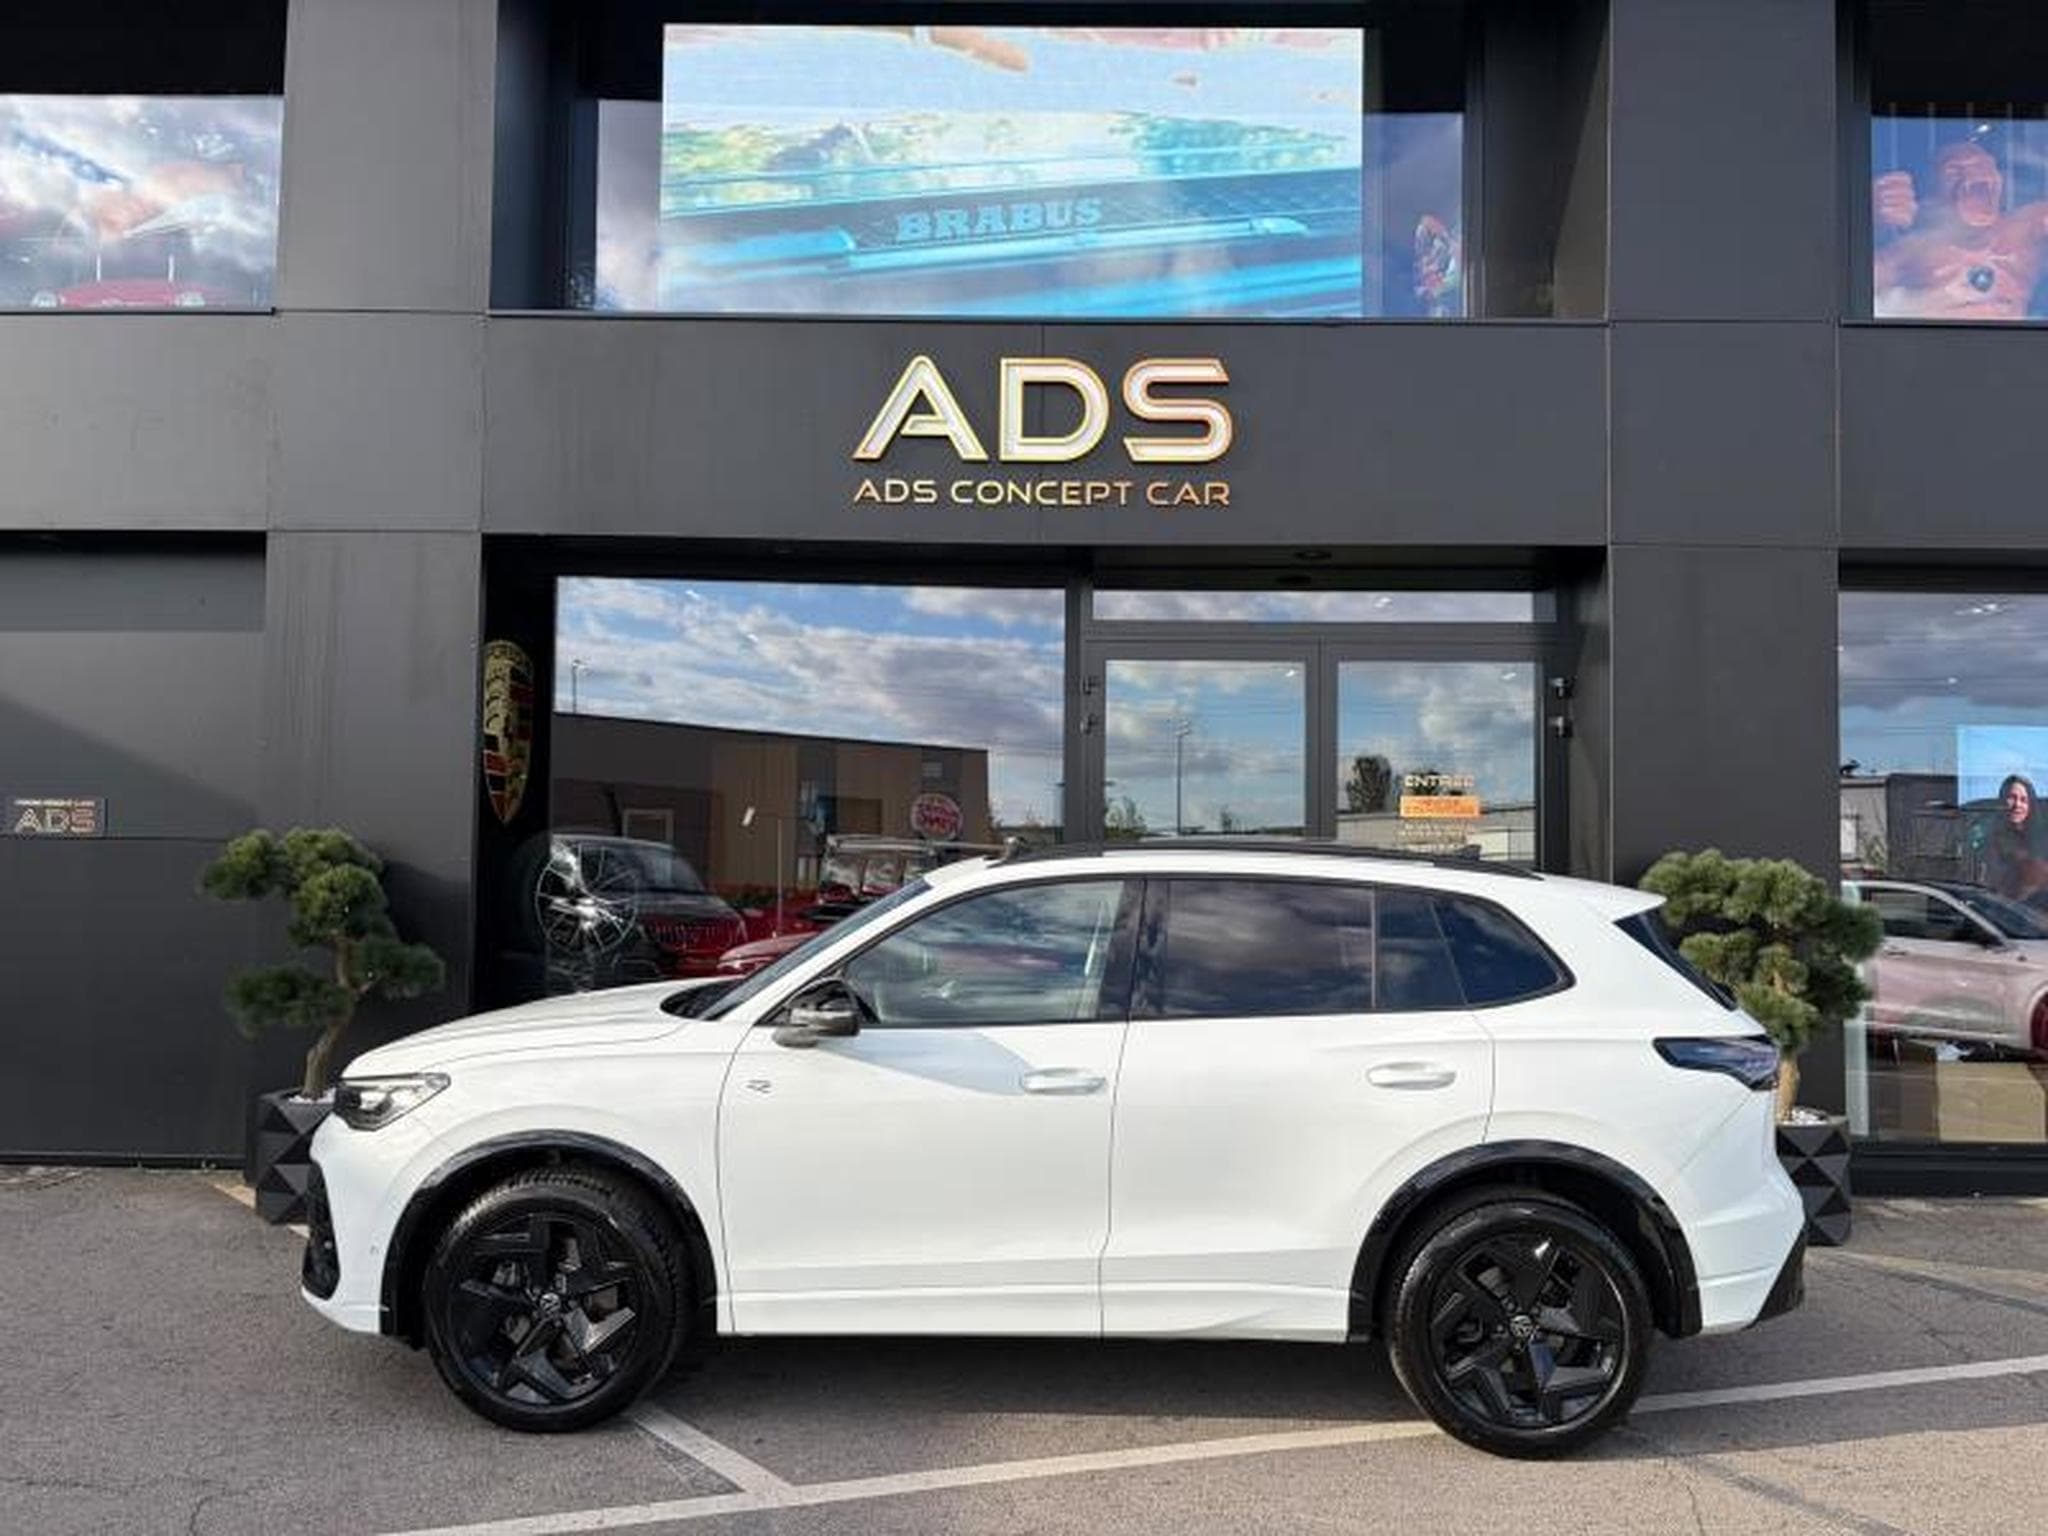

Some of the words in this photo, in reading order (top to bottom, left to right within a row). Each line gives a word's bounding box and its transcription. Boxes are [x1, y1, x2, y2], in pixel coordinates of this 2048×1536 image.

[897, 197, 1101, 242] BRABUS
[852, 355, 1233, 463] ADS
[854, 479, 937, 504] ADS
[951, 479, 1132, 504] CONCEPT
[1147, 481, 1231, 506] CAR
[14, 808, 96, 833] ADS
